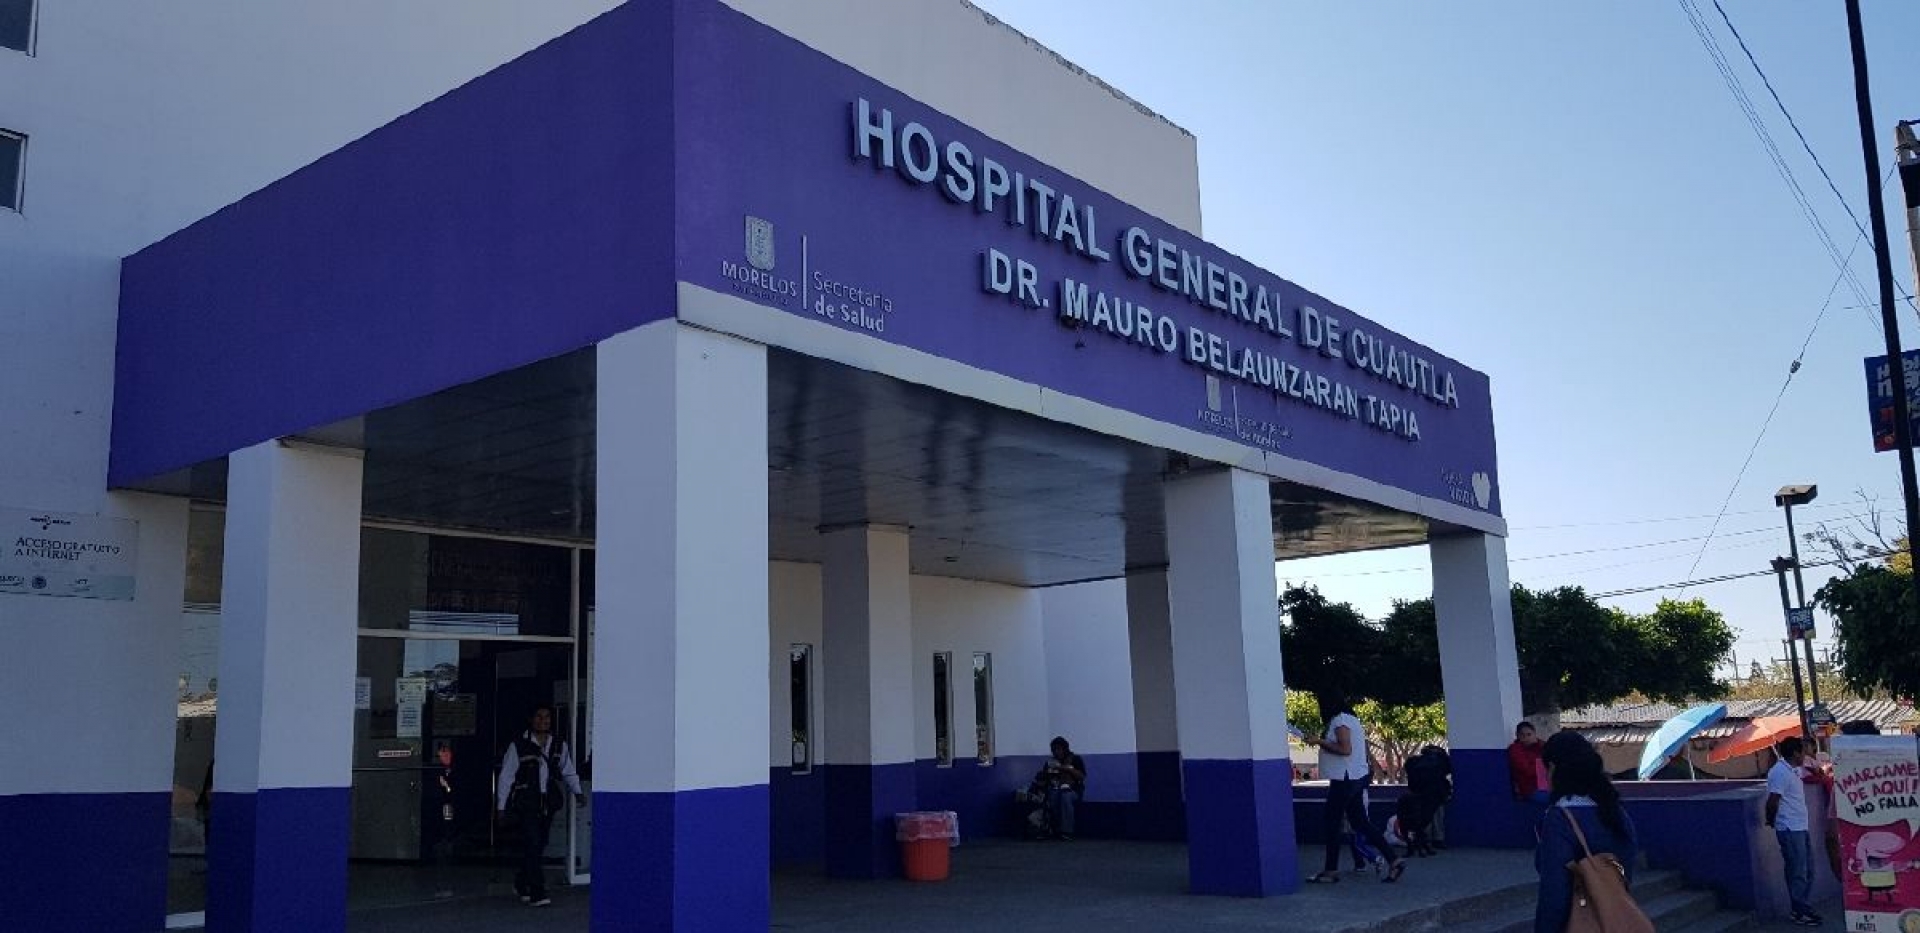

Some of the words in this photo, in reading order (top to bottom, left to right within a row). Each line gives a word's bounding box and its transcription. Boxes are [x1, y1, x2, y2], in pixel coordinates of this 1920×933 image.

[856, 97, 1110, 263] HOSPITAL
[1123, 226, 1293, 339] GENERAL
[1303, 306, 1342, 360] DE
[1350, 329, 1461, 410] CUAUTLA
[722, 260, 797, 297] MORELOS
[815, 294, 835, 319] de
[841, 304, 884, 332] Salud
[988, 247, 1050, 308] DR.
[1064, 278, 1178, 355] MAURO
[1189, 326, 1360, 421] BELAUNZARAN
[1365, 394, 1421, 441] TAPIA
[14, 548, 23, 556] A
[26, 549, 80, 560] INTERNET
[15, 537, 61, 550] ACCESO
[63, 542, 121, 554] GRATUITO
[1847, 788, 1867, 805] DE
[1854, 801, 1875, 818] NO
[1878, 795, 1918, 810] FALLA
